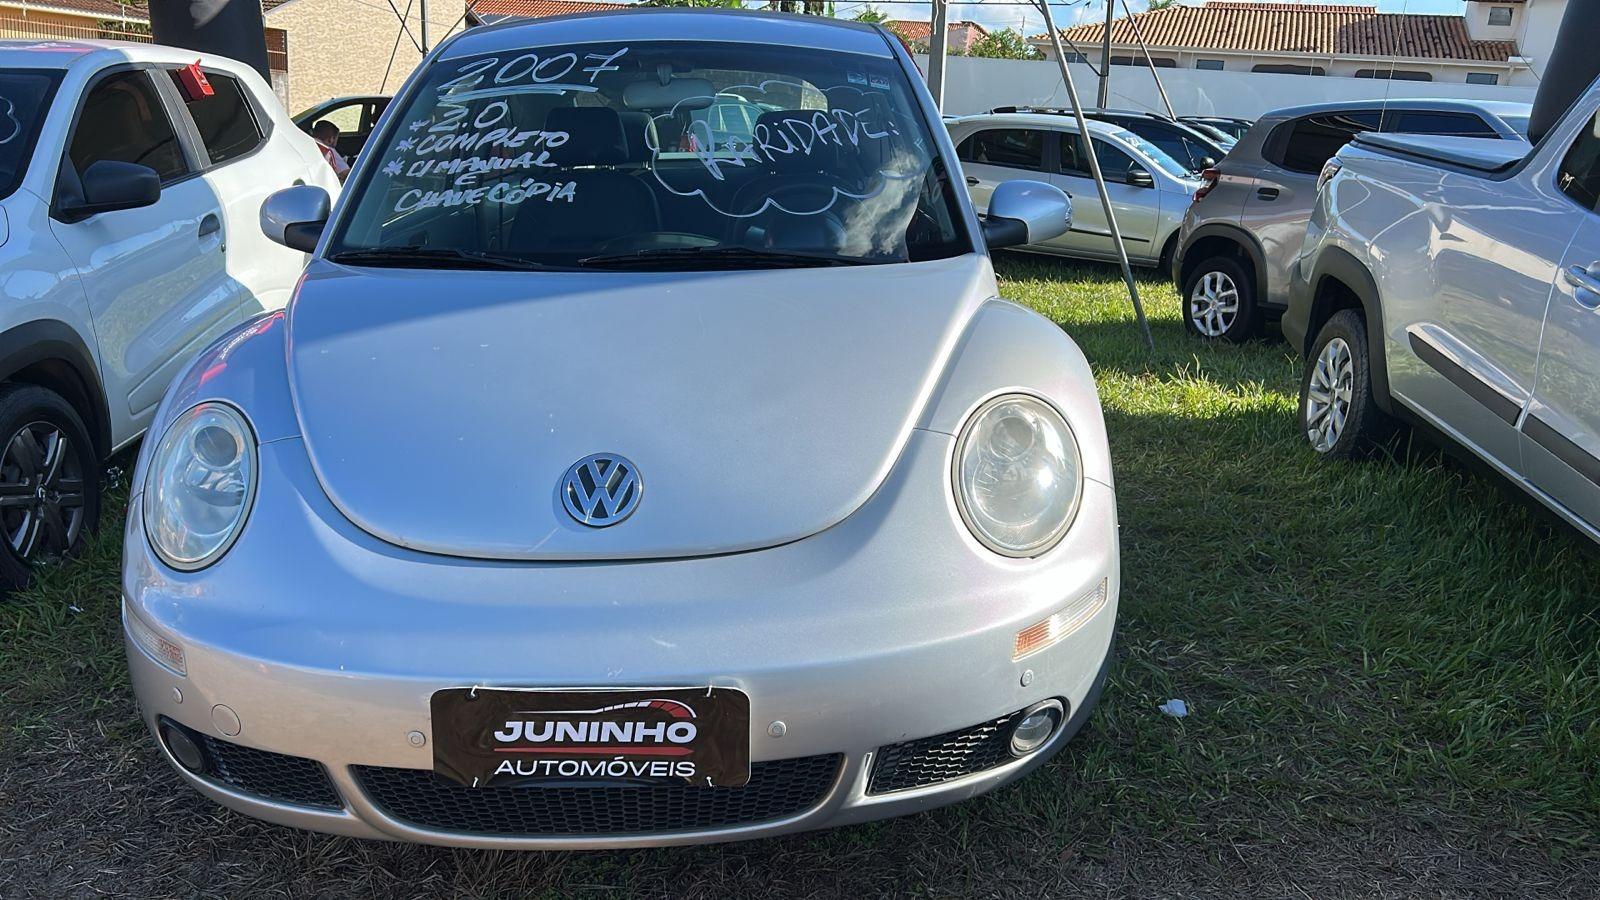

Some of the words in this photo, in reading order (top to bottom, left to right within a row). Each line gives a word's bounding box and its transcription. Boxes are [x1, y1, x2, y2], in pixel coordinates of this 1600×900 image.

[437, 47, 628, 92] 2007
[428, 101, 508, 132] 2.0
[416, 127, 570, 156] COMPLETO
[393, 186, 491, 212] CHAVE
[493, 721, 698, 744] JUNINHO
[493, 756, 696, 777] AUTOMÓVEIS
